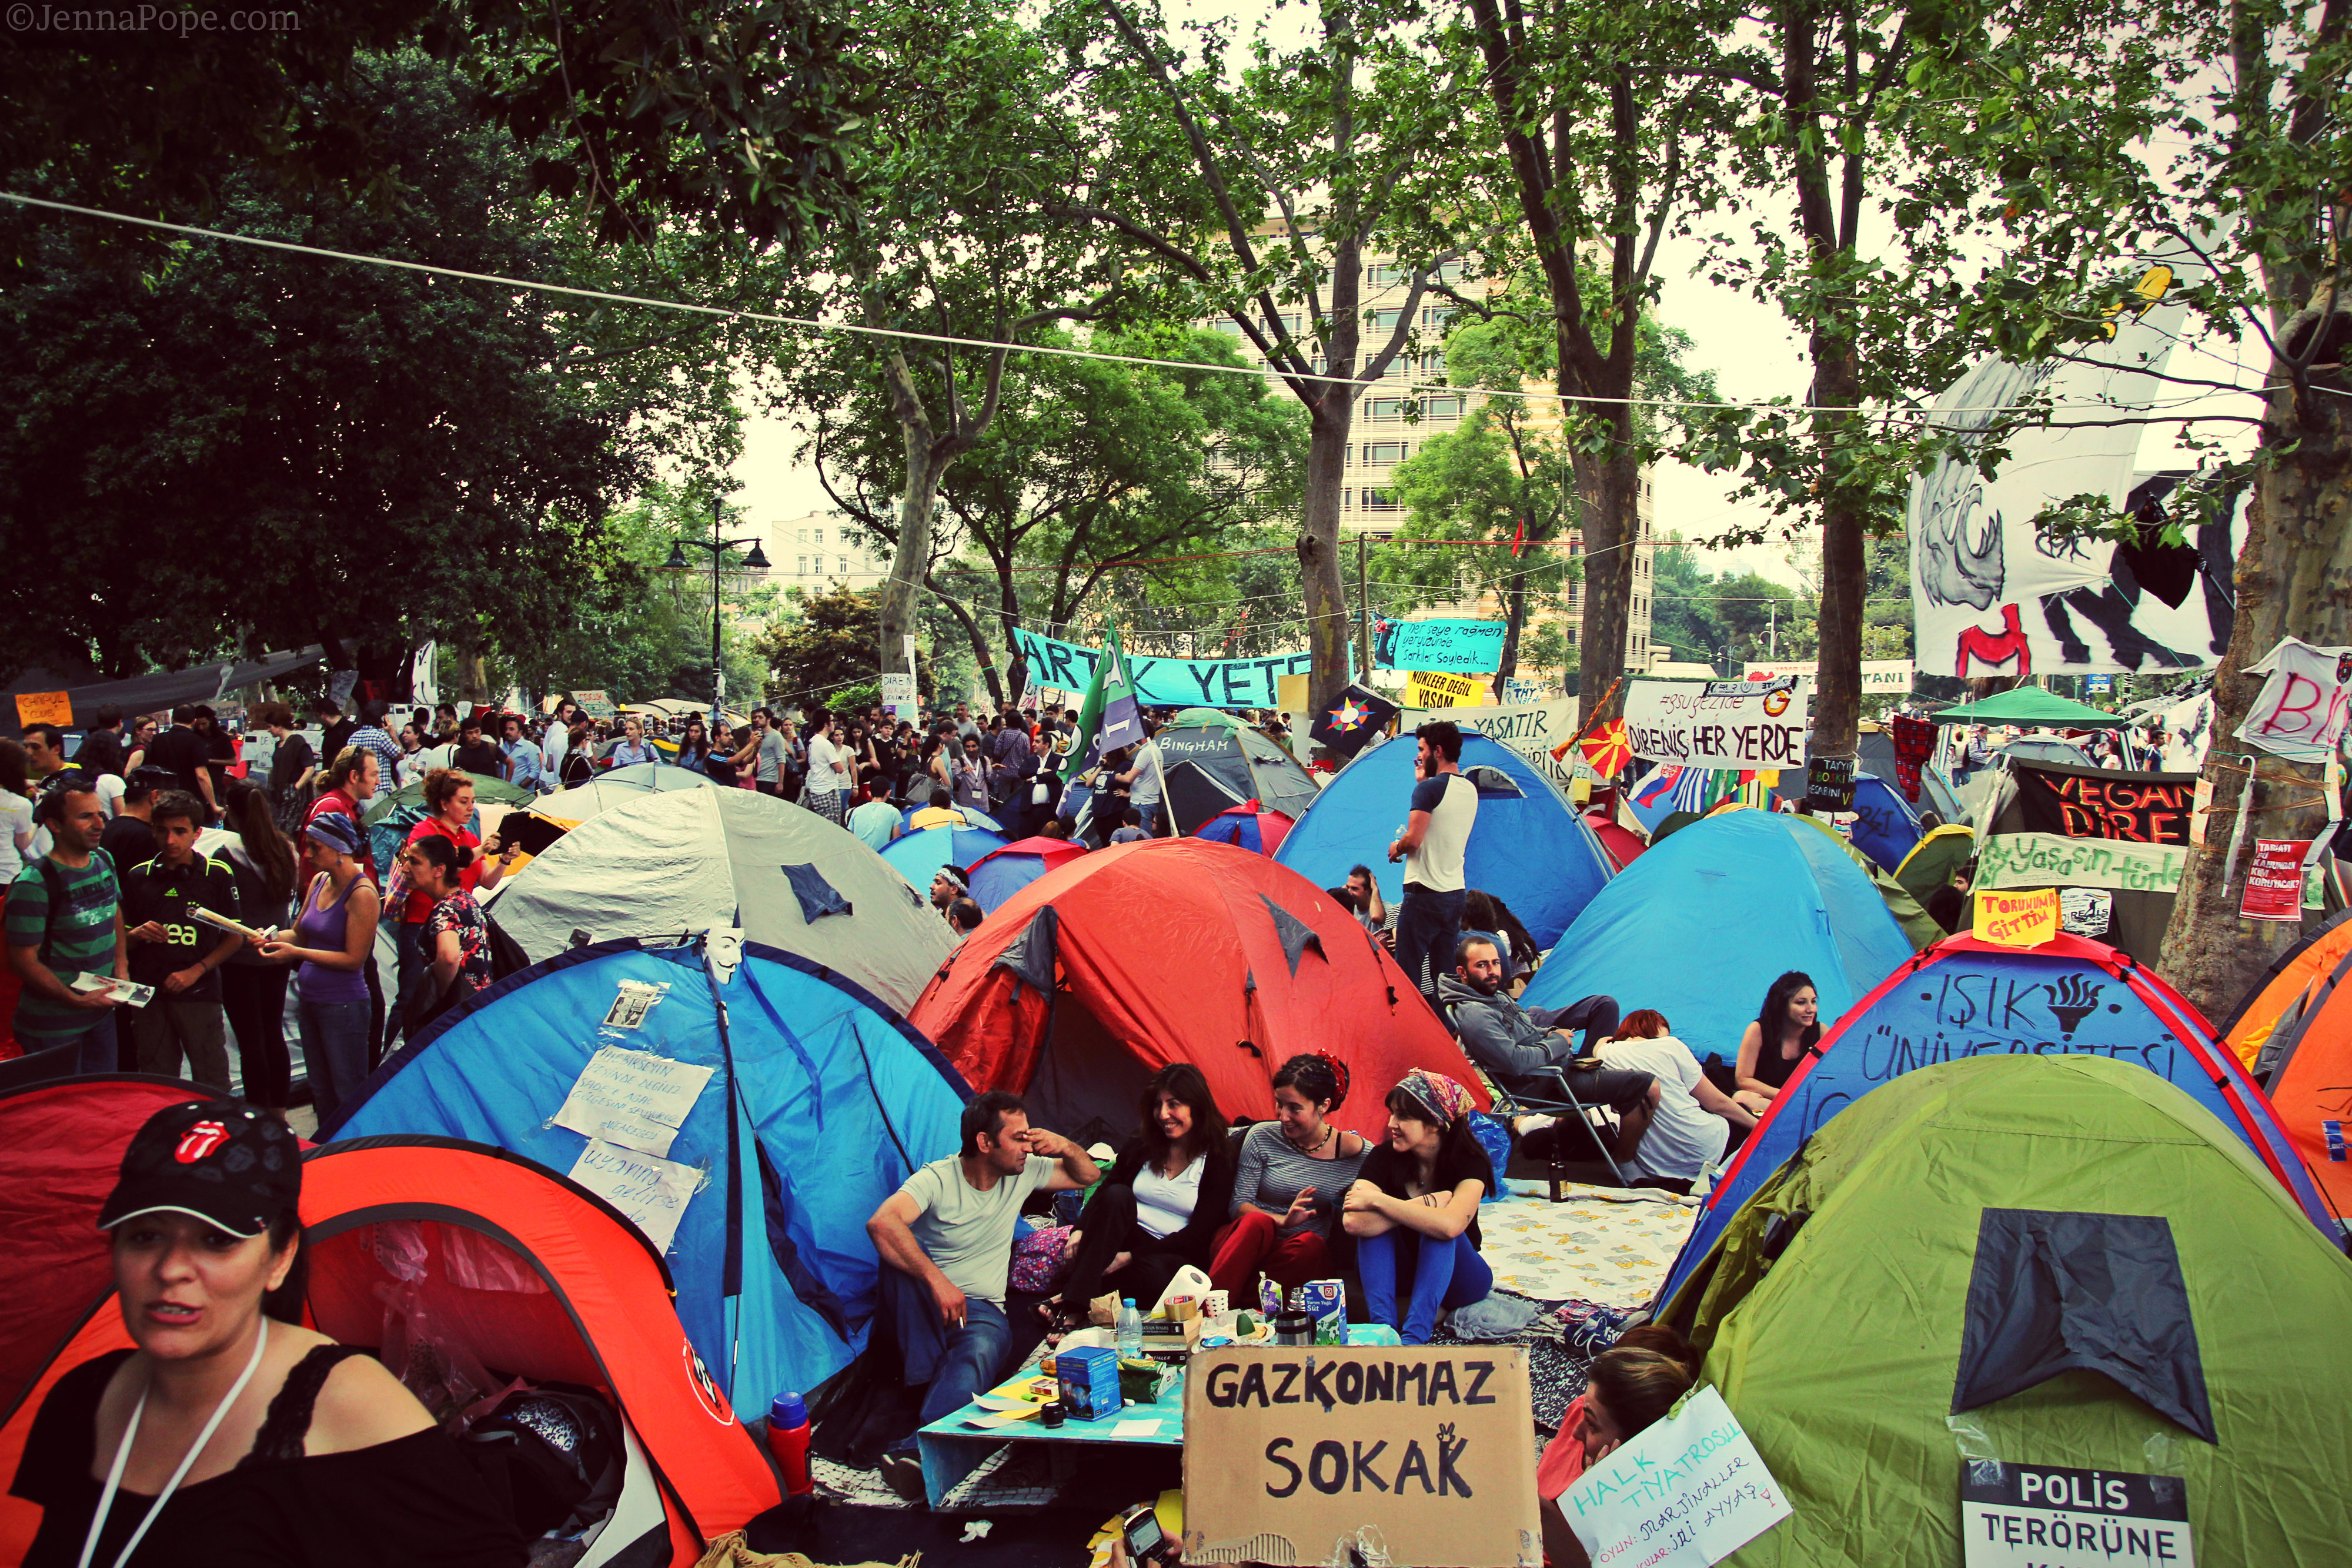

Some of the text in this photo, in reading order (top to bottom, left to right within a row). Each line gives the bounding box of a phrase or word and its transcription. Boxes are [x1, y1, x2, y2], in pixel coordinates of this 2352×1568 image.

[1022, 634, 1161, 700] ARTK
[1514, 688, 1537, 698] THY
[1159, 737, 1228, 754] BINGHAM
[1629, 723, 1803, 765] DİRENİŞ HER YERDE
[2060, 802, 2193, 844] DİRE
[1982, 892, 2056, 914] TORUNUMA
[1937, 973, 2040, 1030] IŞIK
[1205, 1359, 1496, 1409] GAZKONMAZ
[1265, 1437, 1473, 1499] SOKAK
[1573, 1449, 1655, 1517] HALK
[2020, 1472, 2130, 1511] POLİS
[1600, 1456, 1750, 1563] OYUN: MARJİNALLER
[1704, 1482, 1757, 1527] AYYAŞ
[1980, 1513, 2177, 1563] TERÖRÜNE
